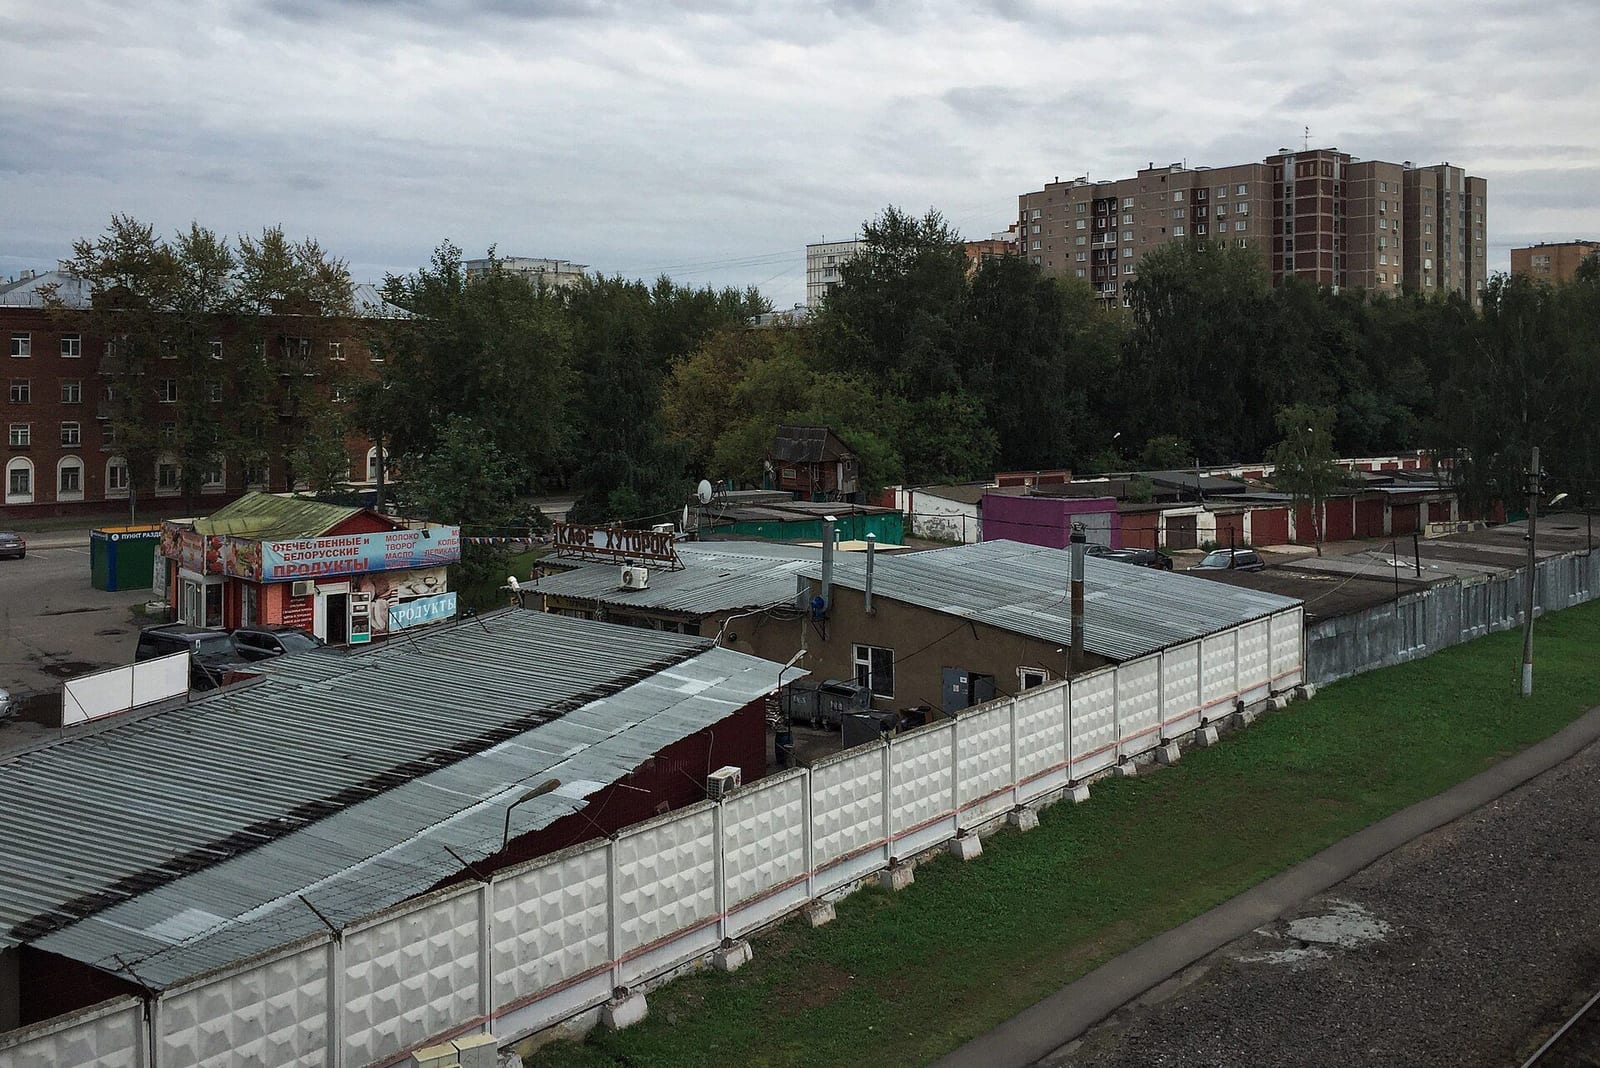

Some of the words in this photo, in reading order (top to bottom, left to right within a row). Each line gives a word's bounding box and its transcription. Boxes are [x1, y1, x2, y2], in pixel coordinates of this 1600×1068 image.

[272, 537, 361, 552] ОТЕЧЕСТВЕННЫЕ
[385, 533, 419, 542] МОЛОКО
[558, 526, 595, 547] КАФЕ
[606, 530, 670, 555] ХУТОРОК
[385, 542, 417, 551] ТВОРОГ
[283, 547, 359, 562] БЕЛОРУССКИЕ
[385, 551, 414, 559] МАСЛО
[273, 557, 369, 577] ПРОДУКТЫ
[389, 597, 457, 625] ПРОДУКТЫ
